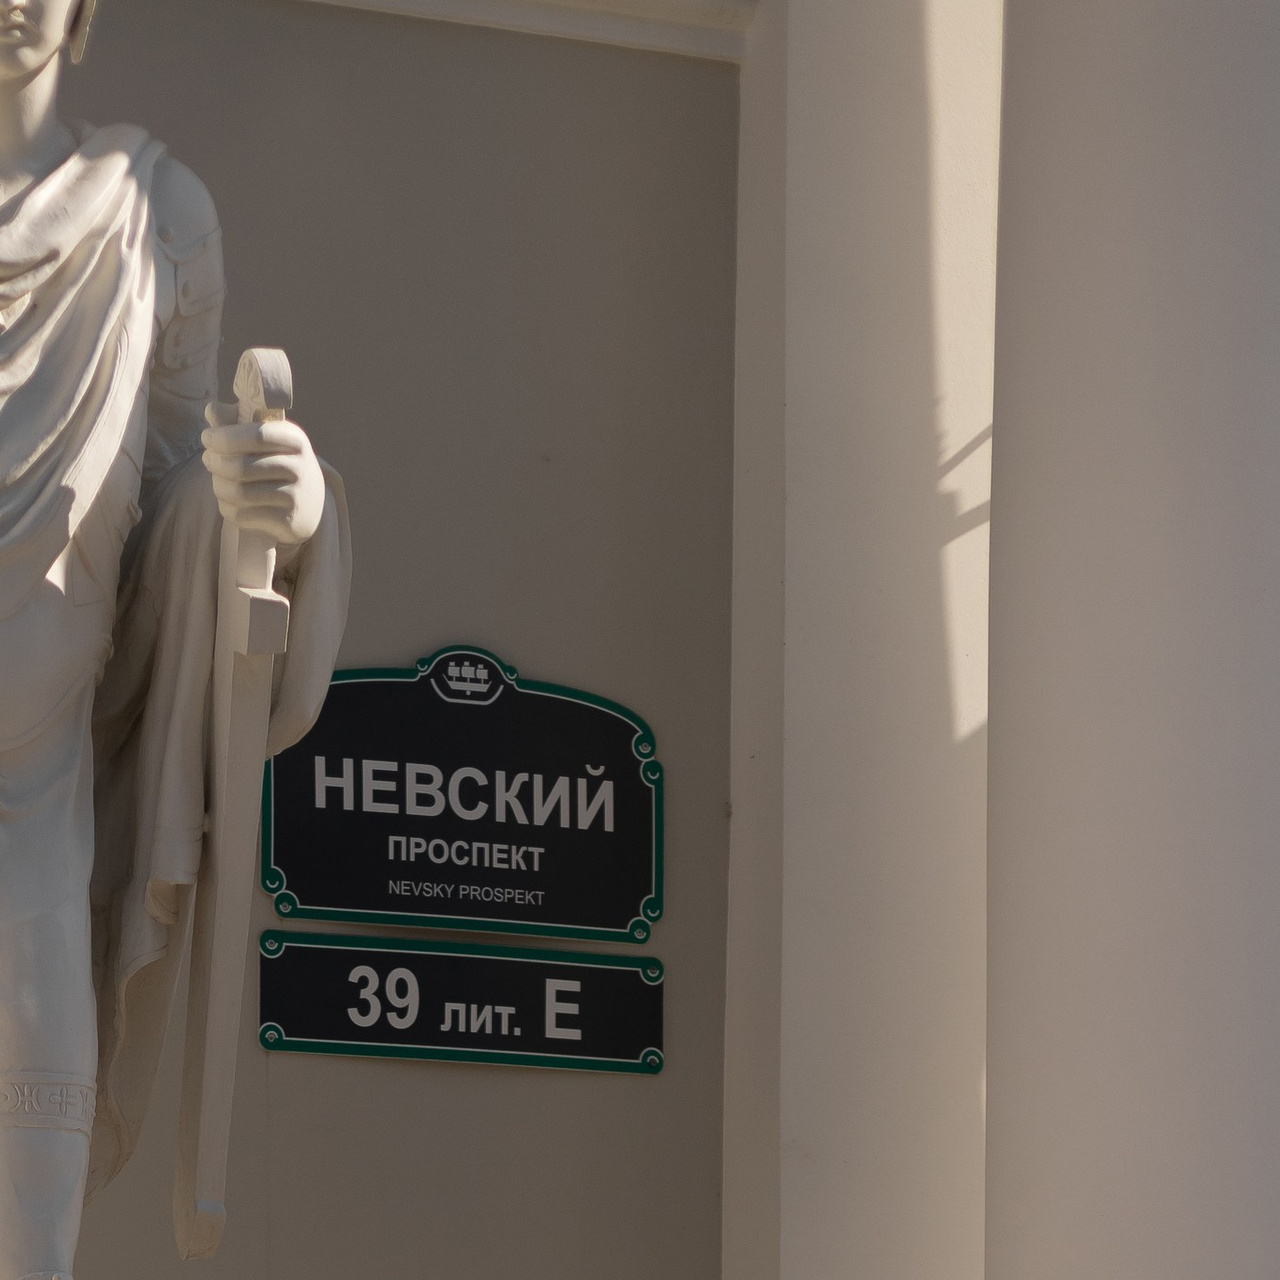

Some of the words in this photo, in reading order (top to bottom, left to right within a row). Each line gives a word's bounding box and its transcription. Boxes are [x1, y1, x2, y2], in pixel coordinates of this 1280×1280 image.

[314, 755, 615, 833] НЕВСКИЙ
[388, 835, 545, 872] ПРОСПЕКТ
[388, 880, 455, 898] NEVSKY
[459, 884, 545, 906] PROSPEKT
[347, 965, 420, 1030] 39
[440, 1001, 522, 1036] лит.
[544, 978, 582, 1041] Е
